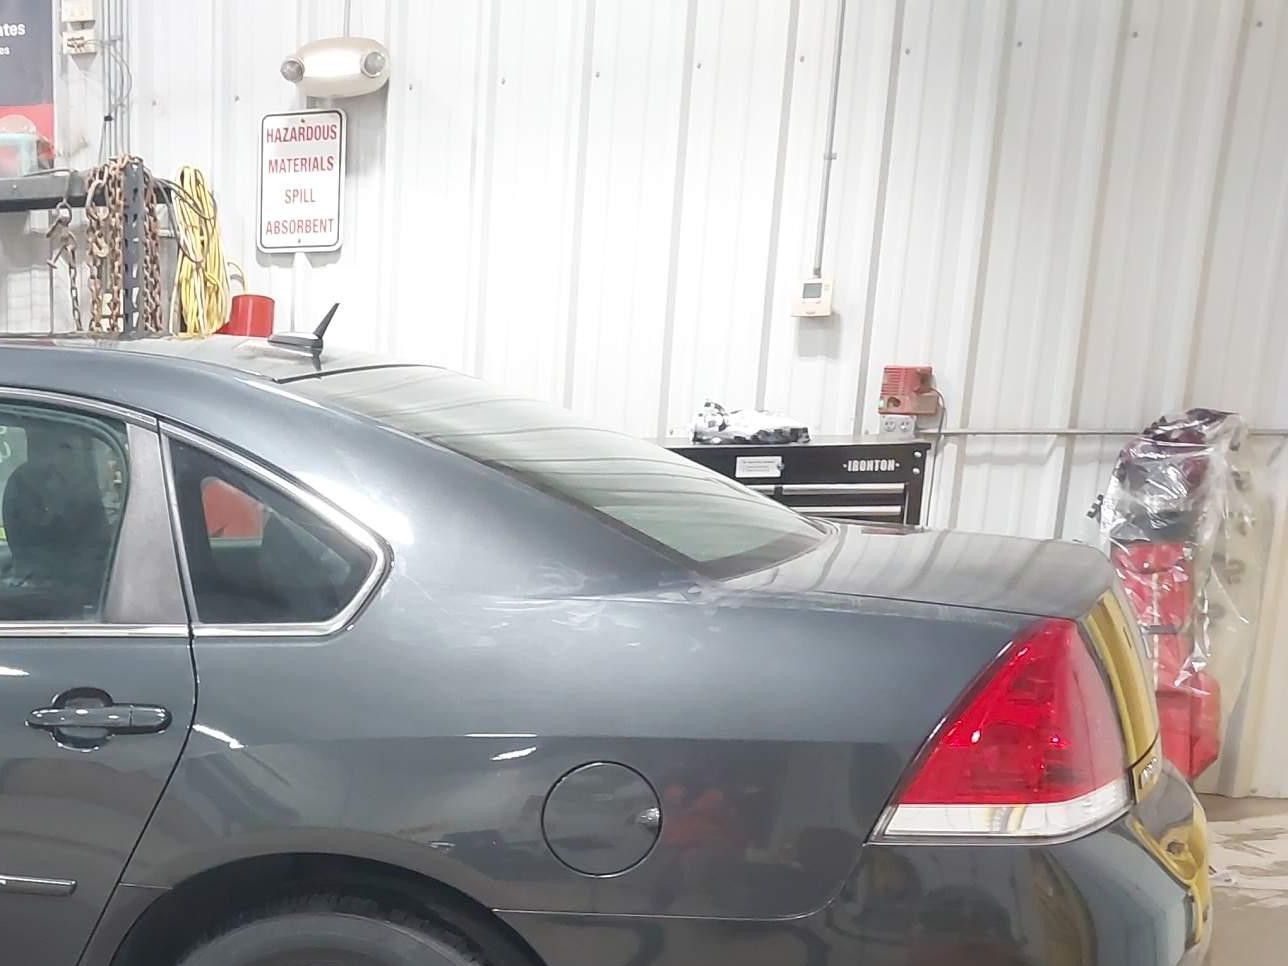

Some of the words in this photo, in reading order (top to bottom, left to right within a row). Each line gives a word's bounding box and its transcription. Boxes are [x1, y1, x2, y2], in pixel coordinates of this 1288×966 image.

[266, 123, 338, 143] HAZARDOUS
[268, 155, 335, 174] MATERIALS
[284, 188, 315, 204] SPILL
[265, 217, 335, 236] ABSORBENT
[847, 458, 896, 473] IRONTON
